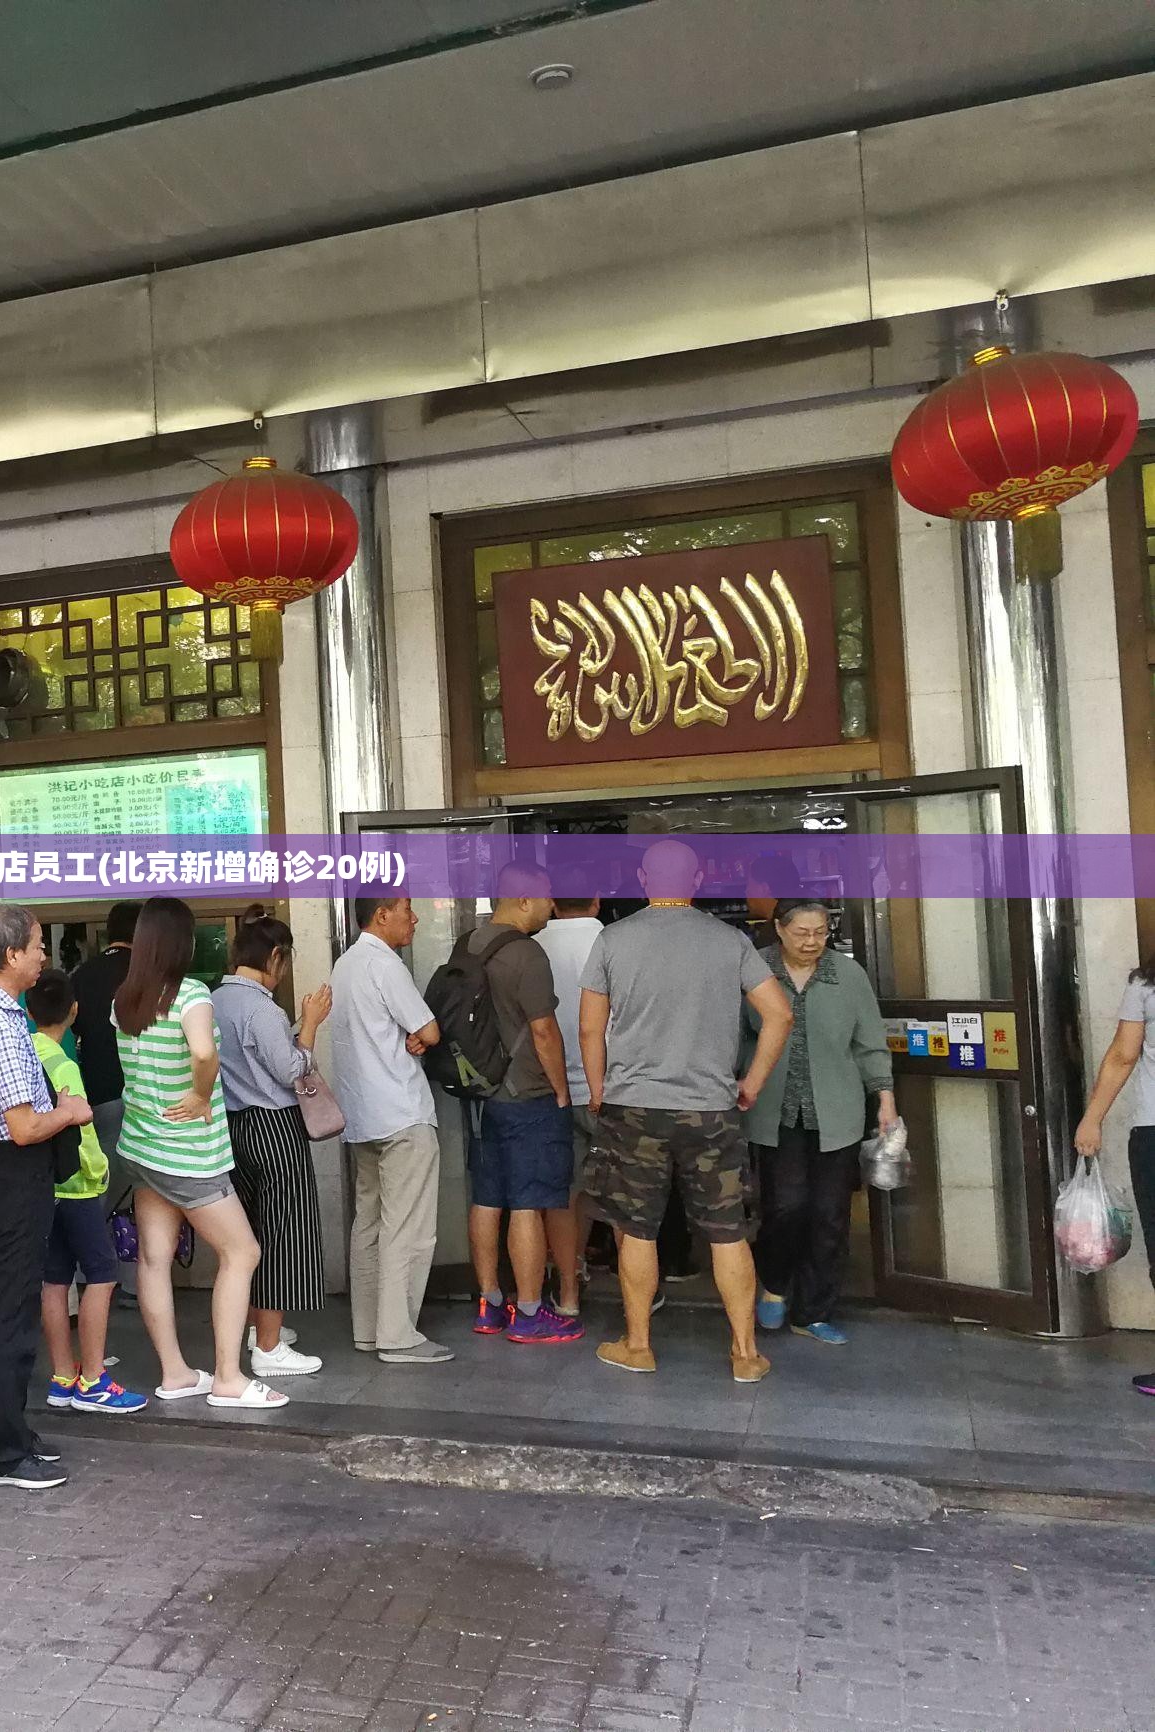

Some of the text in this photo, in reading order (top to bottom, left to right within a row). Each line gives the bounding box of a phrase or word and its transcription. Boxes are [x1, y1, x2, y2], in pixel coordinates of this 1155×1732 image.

[951, 1016, 978, 1025] 江小白
[912, 1033, 925, 1047] 推
[932, 1036, 945, 1049] 推
[993, 1028, 1007, 1043] 推
[959, 1045, 975, 1061] 推
